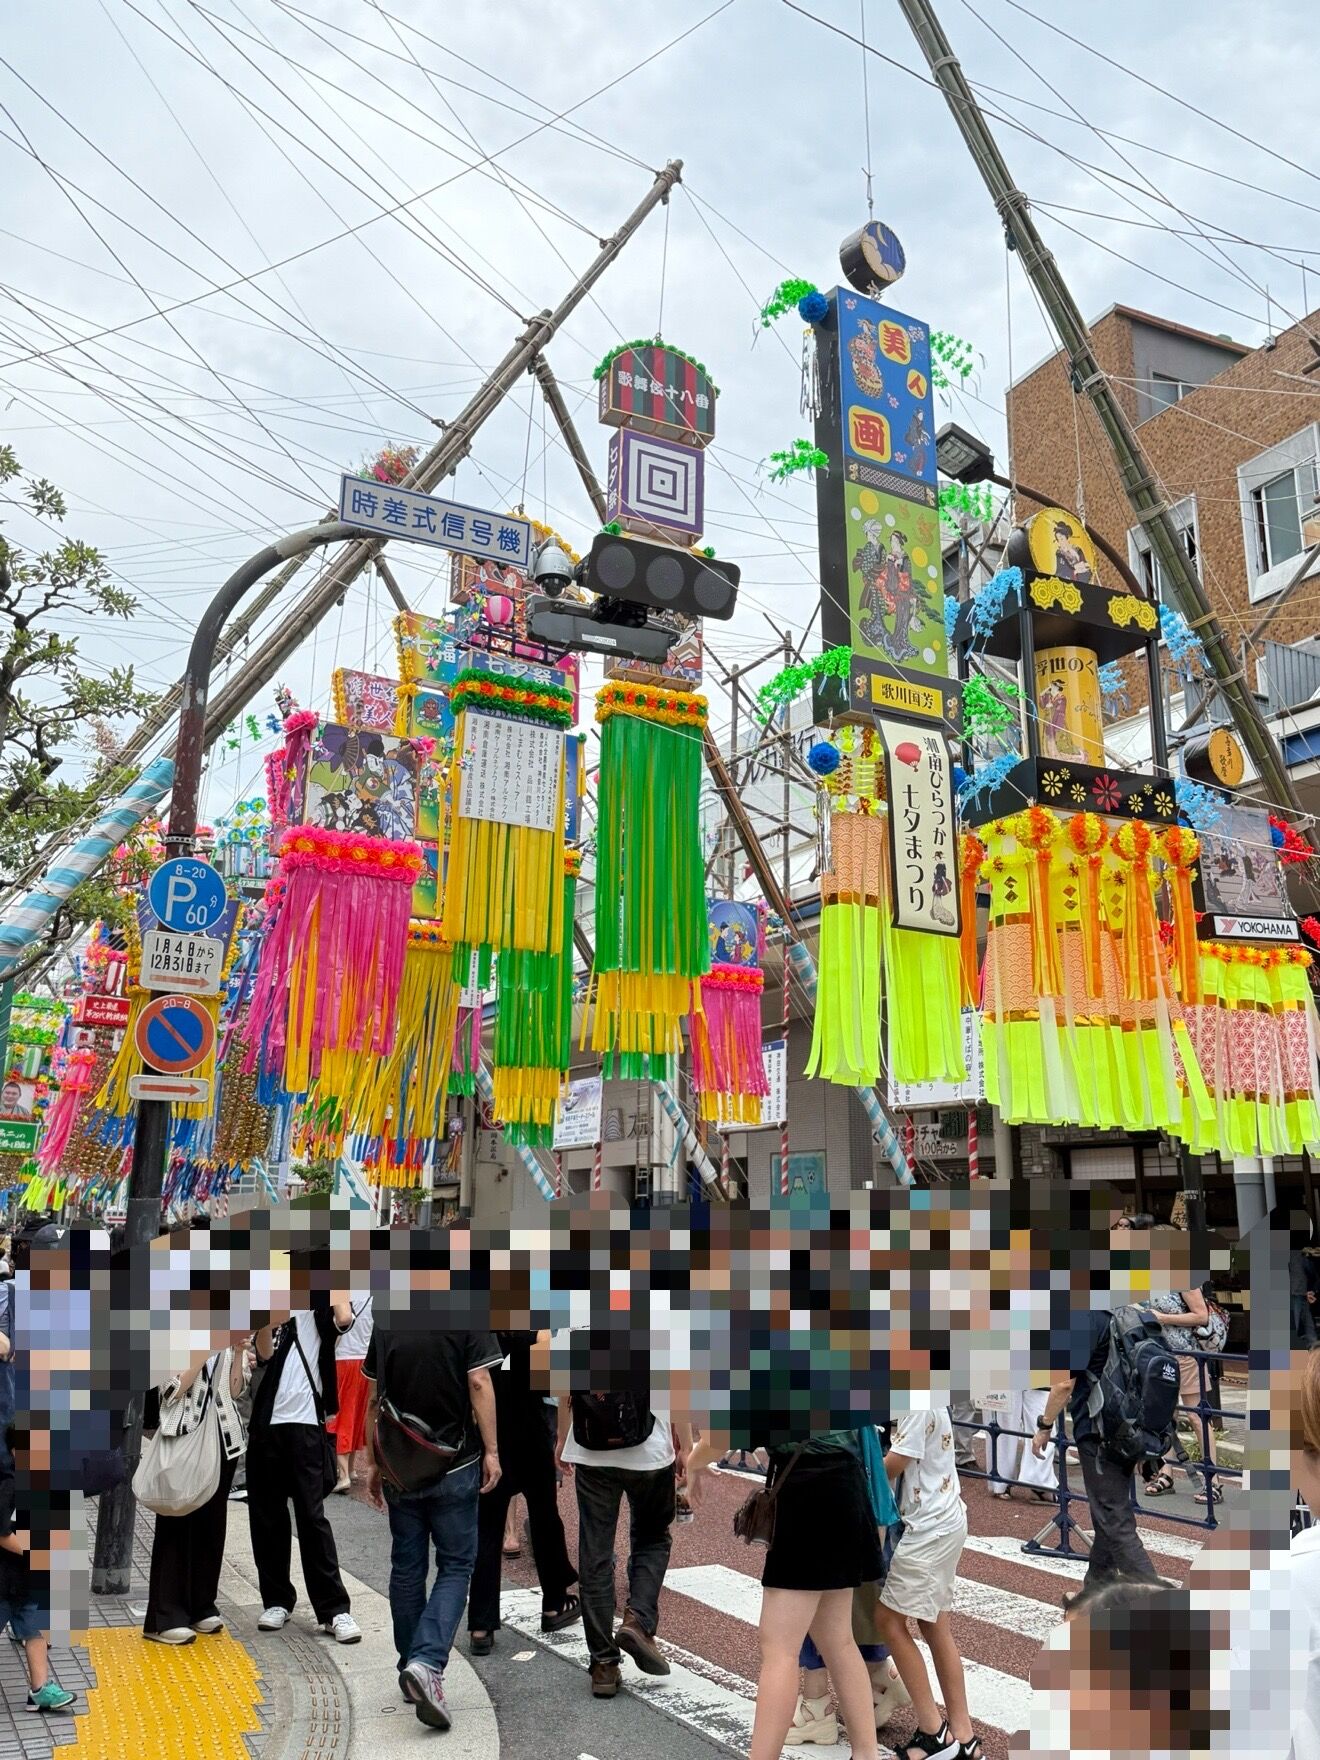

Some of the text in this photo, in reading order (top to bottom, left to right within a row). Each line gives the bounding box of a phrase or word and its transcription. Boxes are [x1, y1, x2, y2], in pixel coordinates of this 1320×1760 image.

[617, 369, 709, 410] 歌舞伎十八番
[608, 446, 619, 512] 七夕祭
[351, 488, 522, 555] 時差式信号機
[485, 656, 552, 685] 七夕祭
[881, 683, 934, 709] 歌川国芳
[527, 730, 536, 769] 株式会社
[922, 736, 947, 846] 湘南ひらつか
[903, 784, 925, 912] 七夕まつり
[175, 863, 207, 880] 8-20
[165, 875, 217, 926] P 分 60
[1237, 921, 1293, 936] YOKOHAMA
[155, 937, 215, 960] 1月4日から
[162, 998, 192, 1009] 20-8
